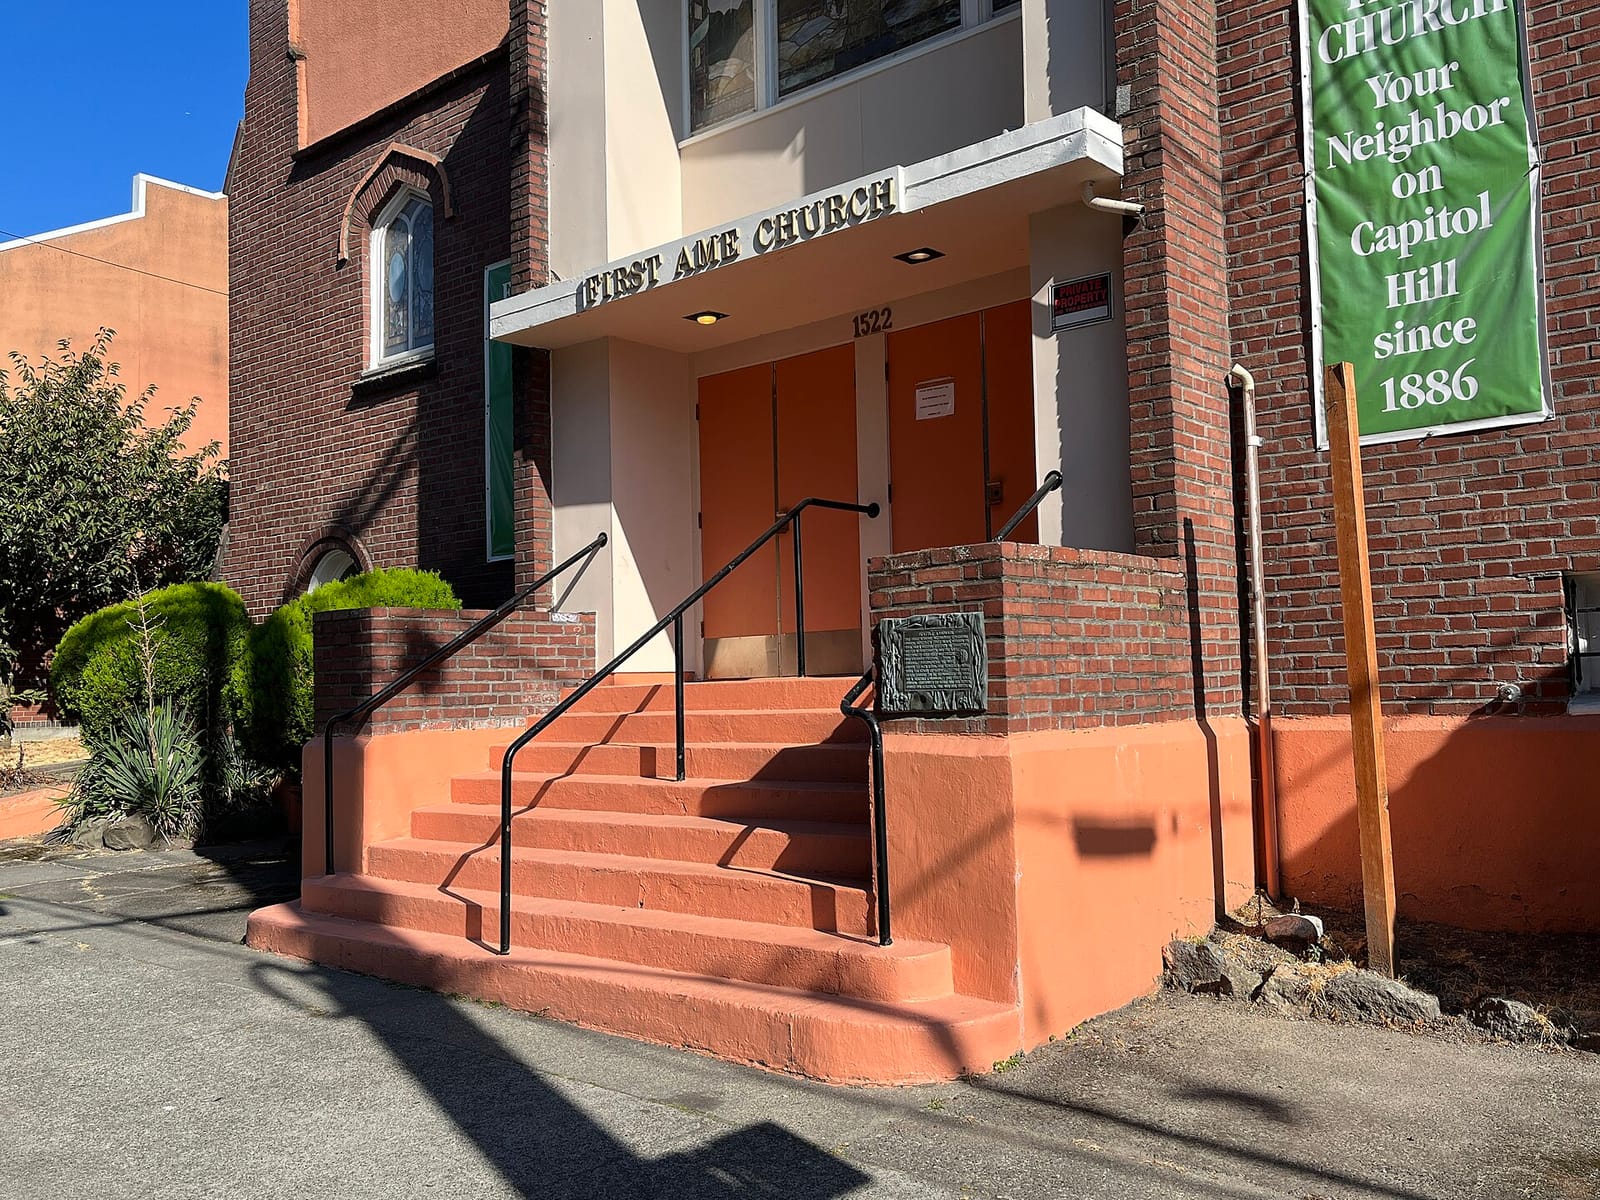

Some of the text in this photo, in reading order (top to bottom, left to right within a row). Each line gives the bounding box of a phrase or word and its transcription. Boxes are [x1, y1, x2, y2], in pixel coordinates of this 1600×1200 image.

[1365, 61, 1459, 110] Your
[1326, 96, 1510, 169] Neighbor
[1391, 163, 1445, 199] on
[584, 177, 896, 307] FIRST AME CHURCH
[1350, 190, 1494, 260] Capitol
[1055, 288, 1107, 310] PROPERTY
[1059, 279, 1102, 297] PRIVATE
[1384, 258, 1460, 309] Hill
[852, 307, 893, 338] 1522
[1373, 315, 1477, 360] since
[1379, 358, 1479, 413] 1886
